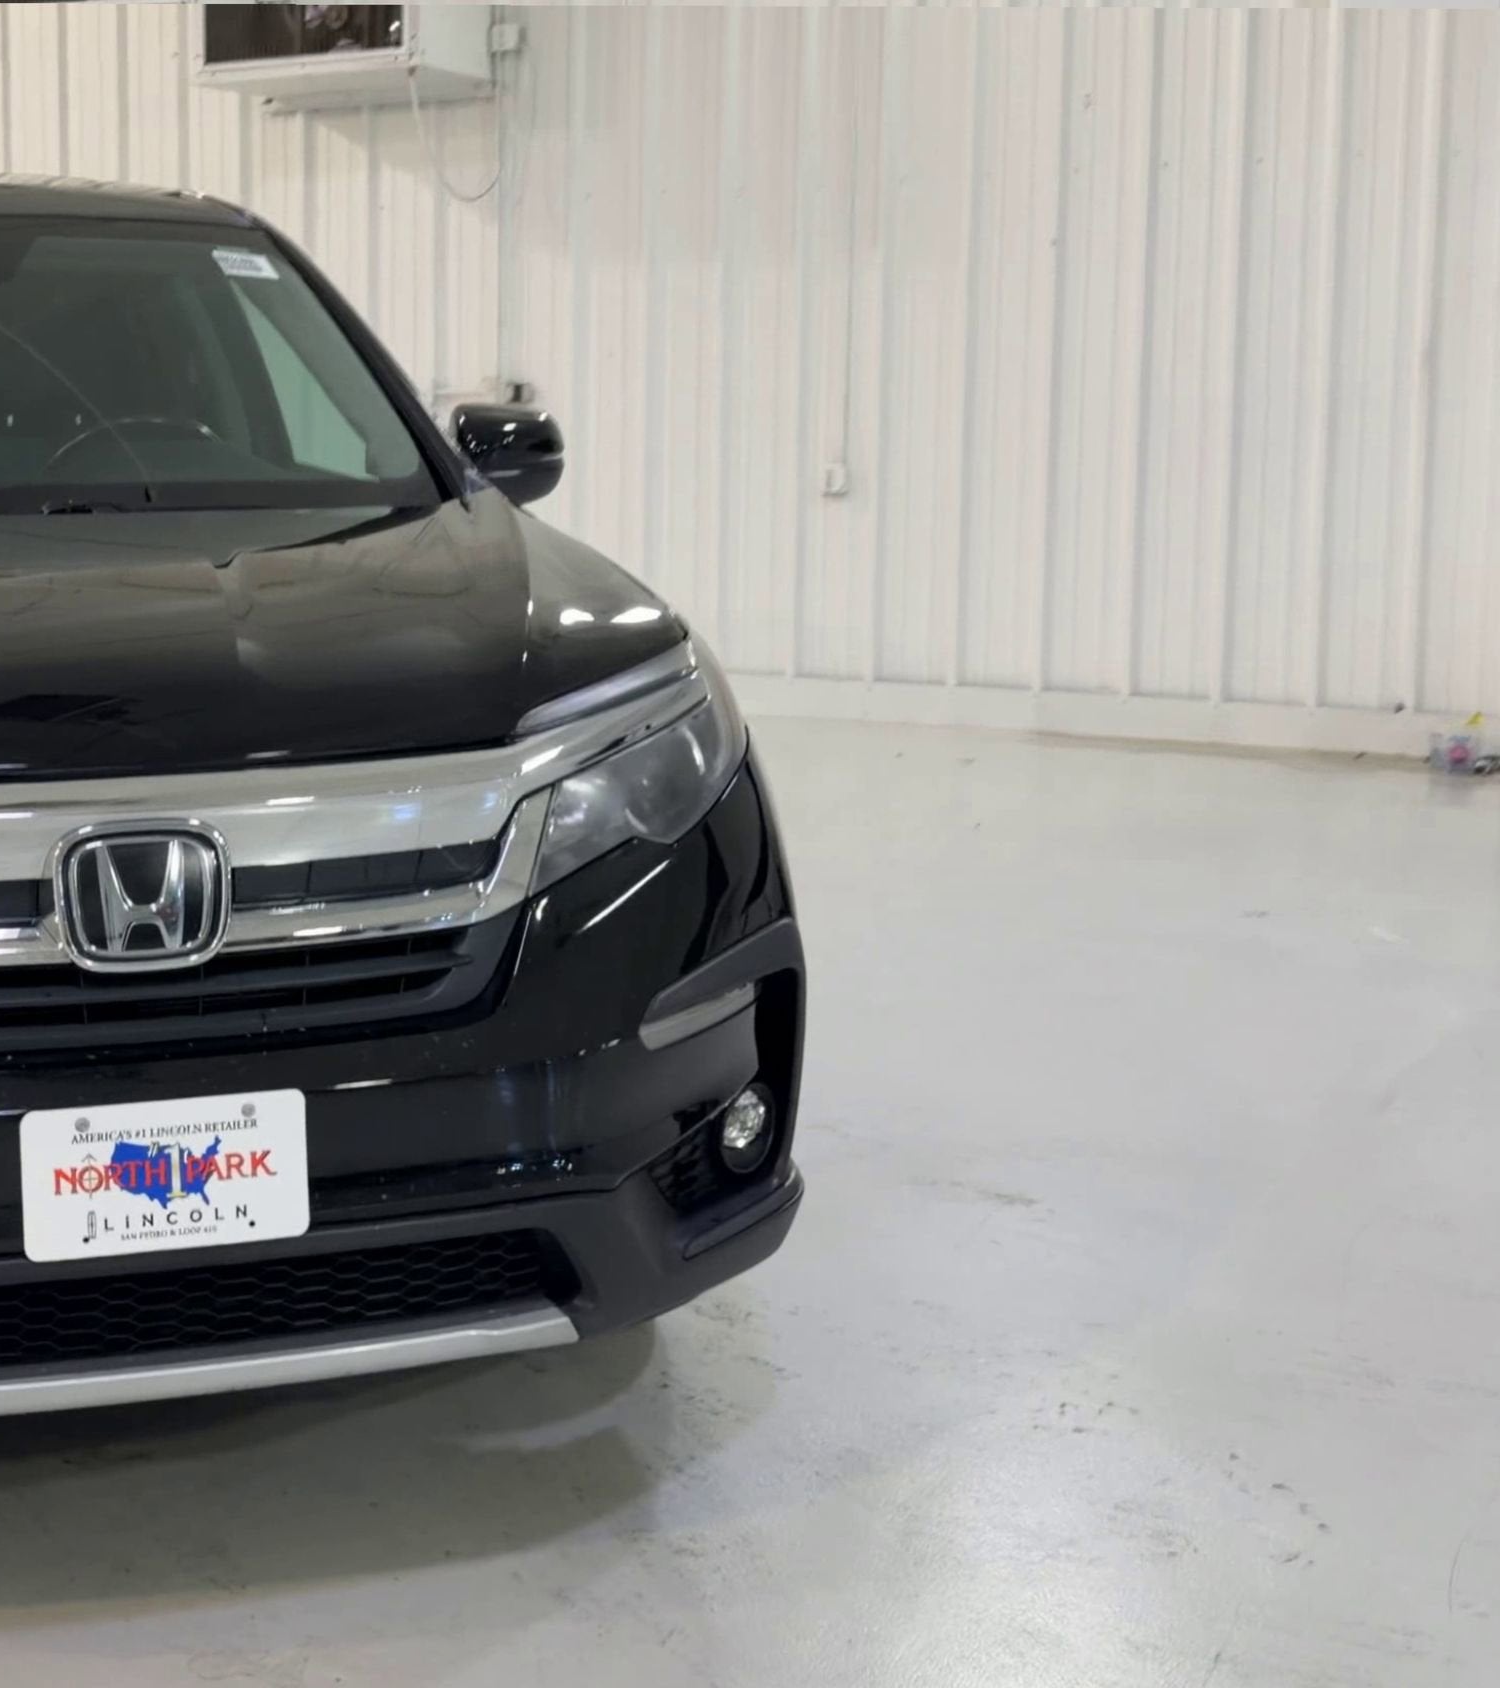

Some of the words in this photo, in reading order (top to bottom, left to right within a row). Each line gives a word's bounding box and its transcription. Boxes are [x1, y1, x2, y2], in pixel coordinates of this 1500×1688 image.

[71, 1130, 132, 1145] AMERICA'S
[150, 1123, 202, 1138] LINCOLN
[204, 1118, 258, 1133] RETAILER
[53, 1157, 168, 1197] NORTH
[186, 1149, 277, 1184] PARK
[104, 1204, 248, 1232] LINCOLN
